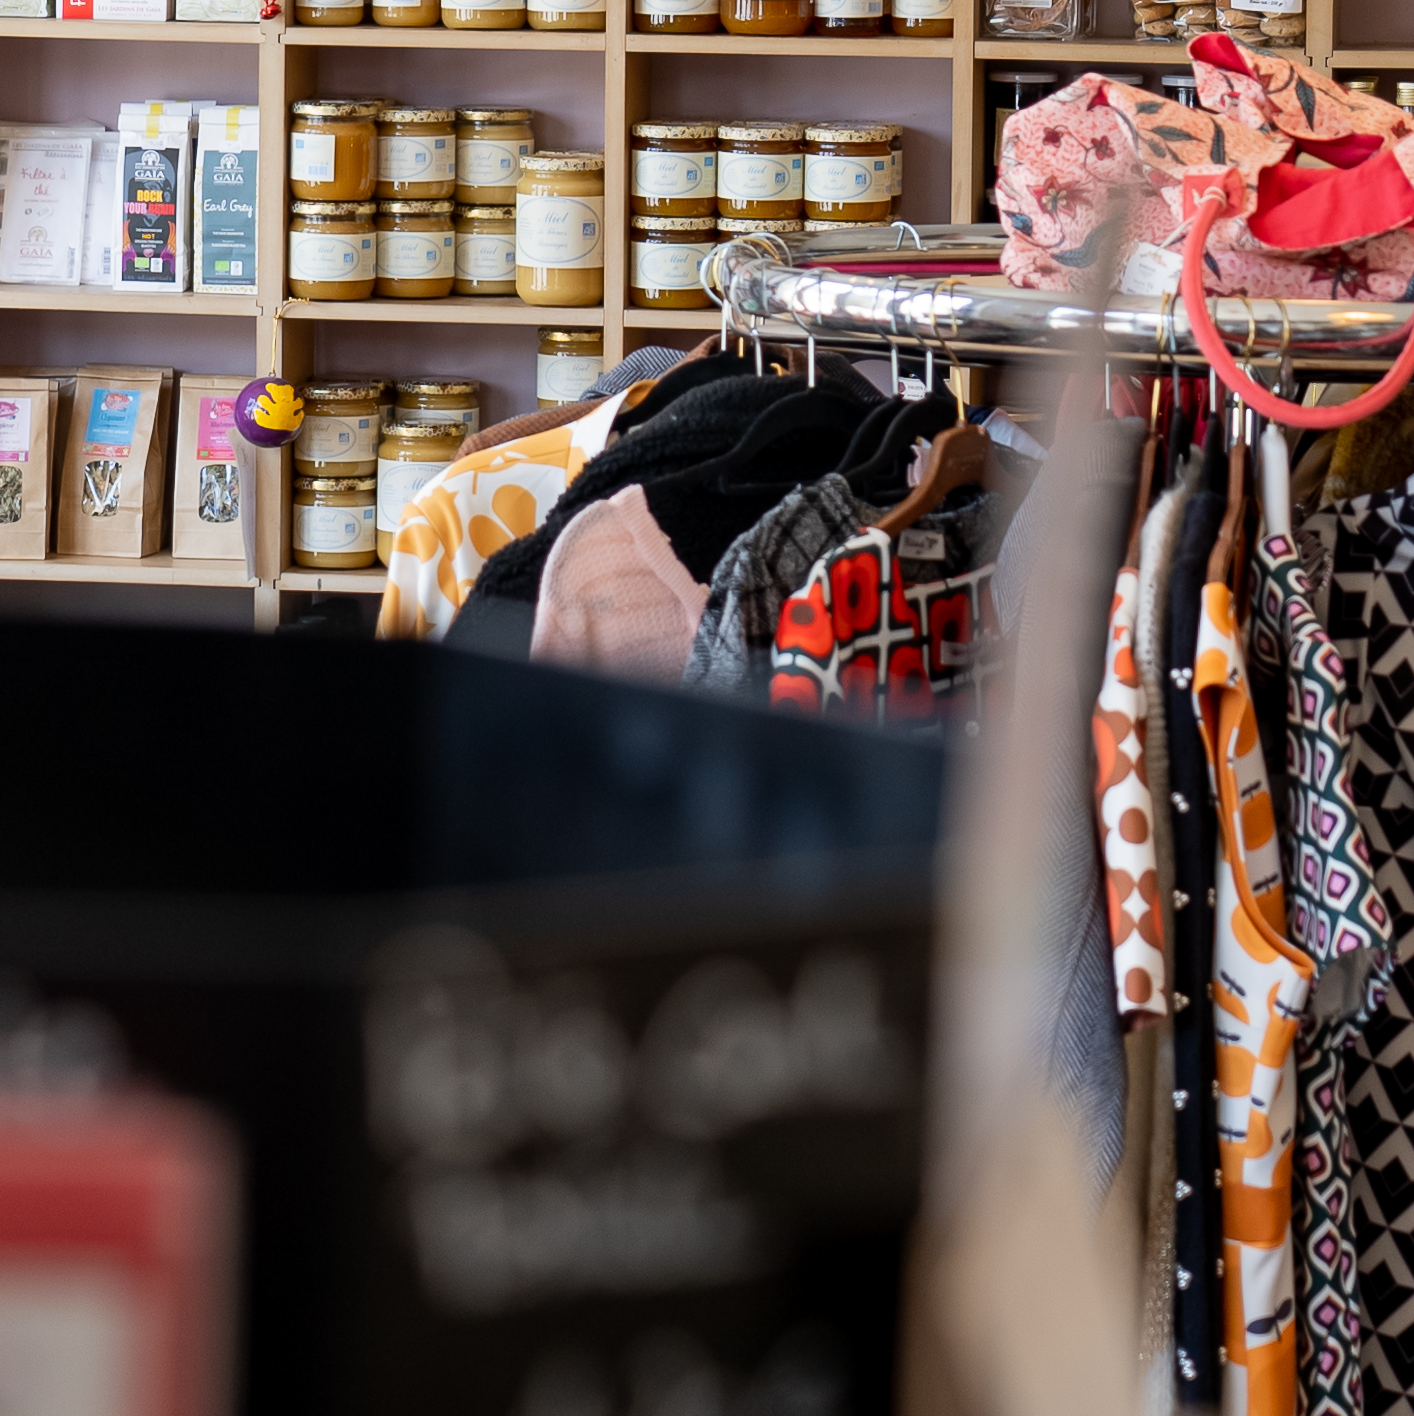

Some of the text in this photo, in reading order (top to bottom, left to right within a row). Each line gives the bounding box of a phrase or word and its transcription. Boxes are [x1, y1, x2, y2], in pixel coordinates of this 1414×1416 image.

[135, 169, 165, 178] GAÏA
[213, 173, 243, 183] GAÏA
[137, 189, 163, 202] ROCK
[124, 202, 175, 215] YOUR BRAIN
[203, 198, 253, 218] Earl Grey
[20, 247, 53, 258] GAÏA
